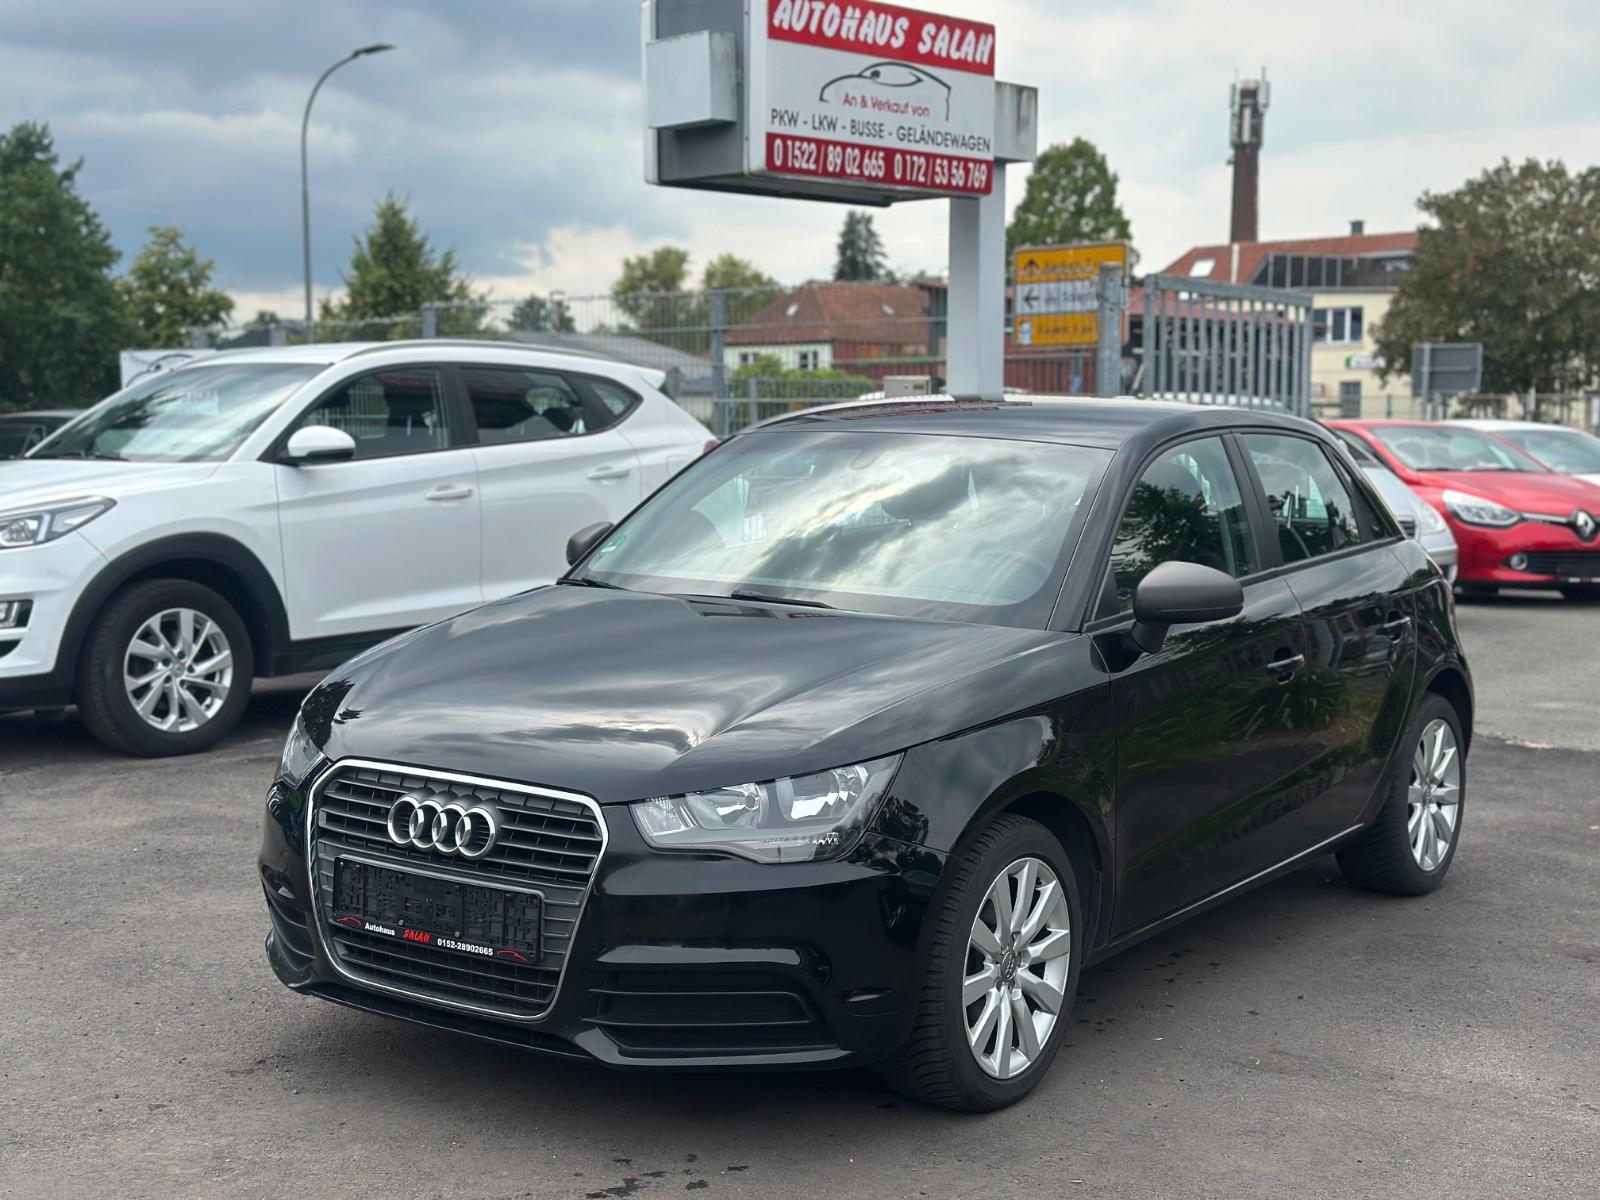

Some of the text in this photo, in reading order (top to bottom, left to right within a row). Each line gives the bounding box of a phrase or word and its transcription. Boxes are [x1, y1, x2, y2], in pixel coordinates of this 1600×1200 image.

[773, 0, 993, 65] AUTOHAUS SALAH
[842, 92, 929, 118] An & Verkauf von
[771, 108, 799, 128] PKW
[812, 113, 838, 132] LKW
[850, 119, 885, 139] BUSSE
[896, 124, 991, 153] GELÄNDEWAGEN
[862, 149, 885, 178] 665
[967, 162, 988, 189] 769
[364, 922, 395, 936] Autohaus
[437, 938, 493, 956] 0152-28902665
